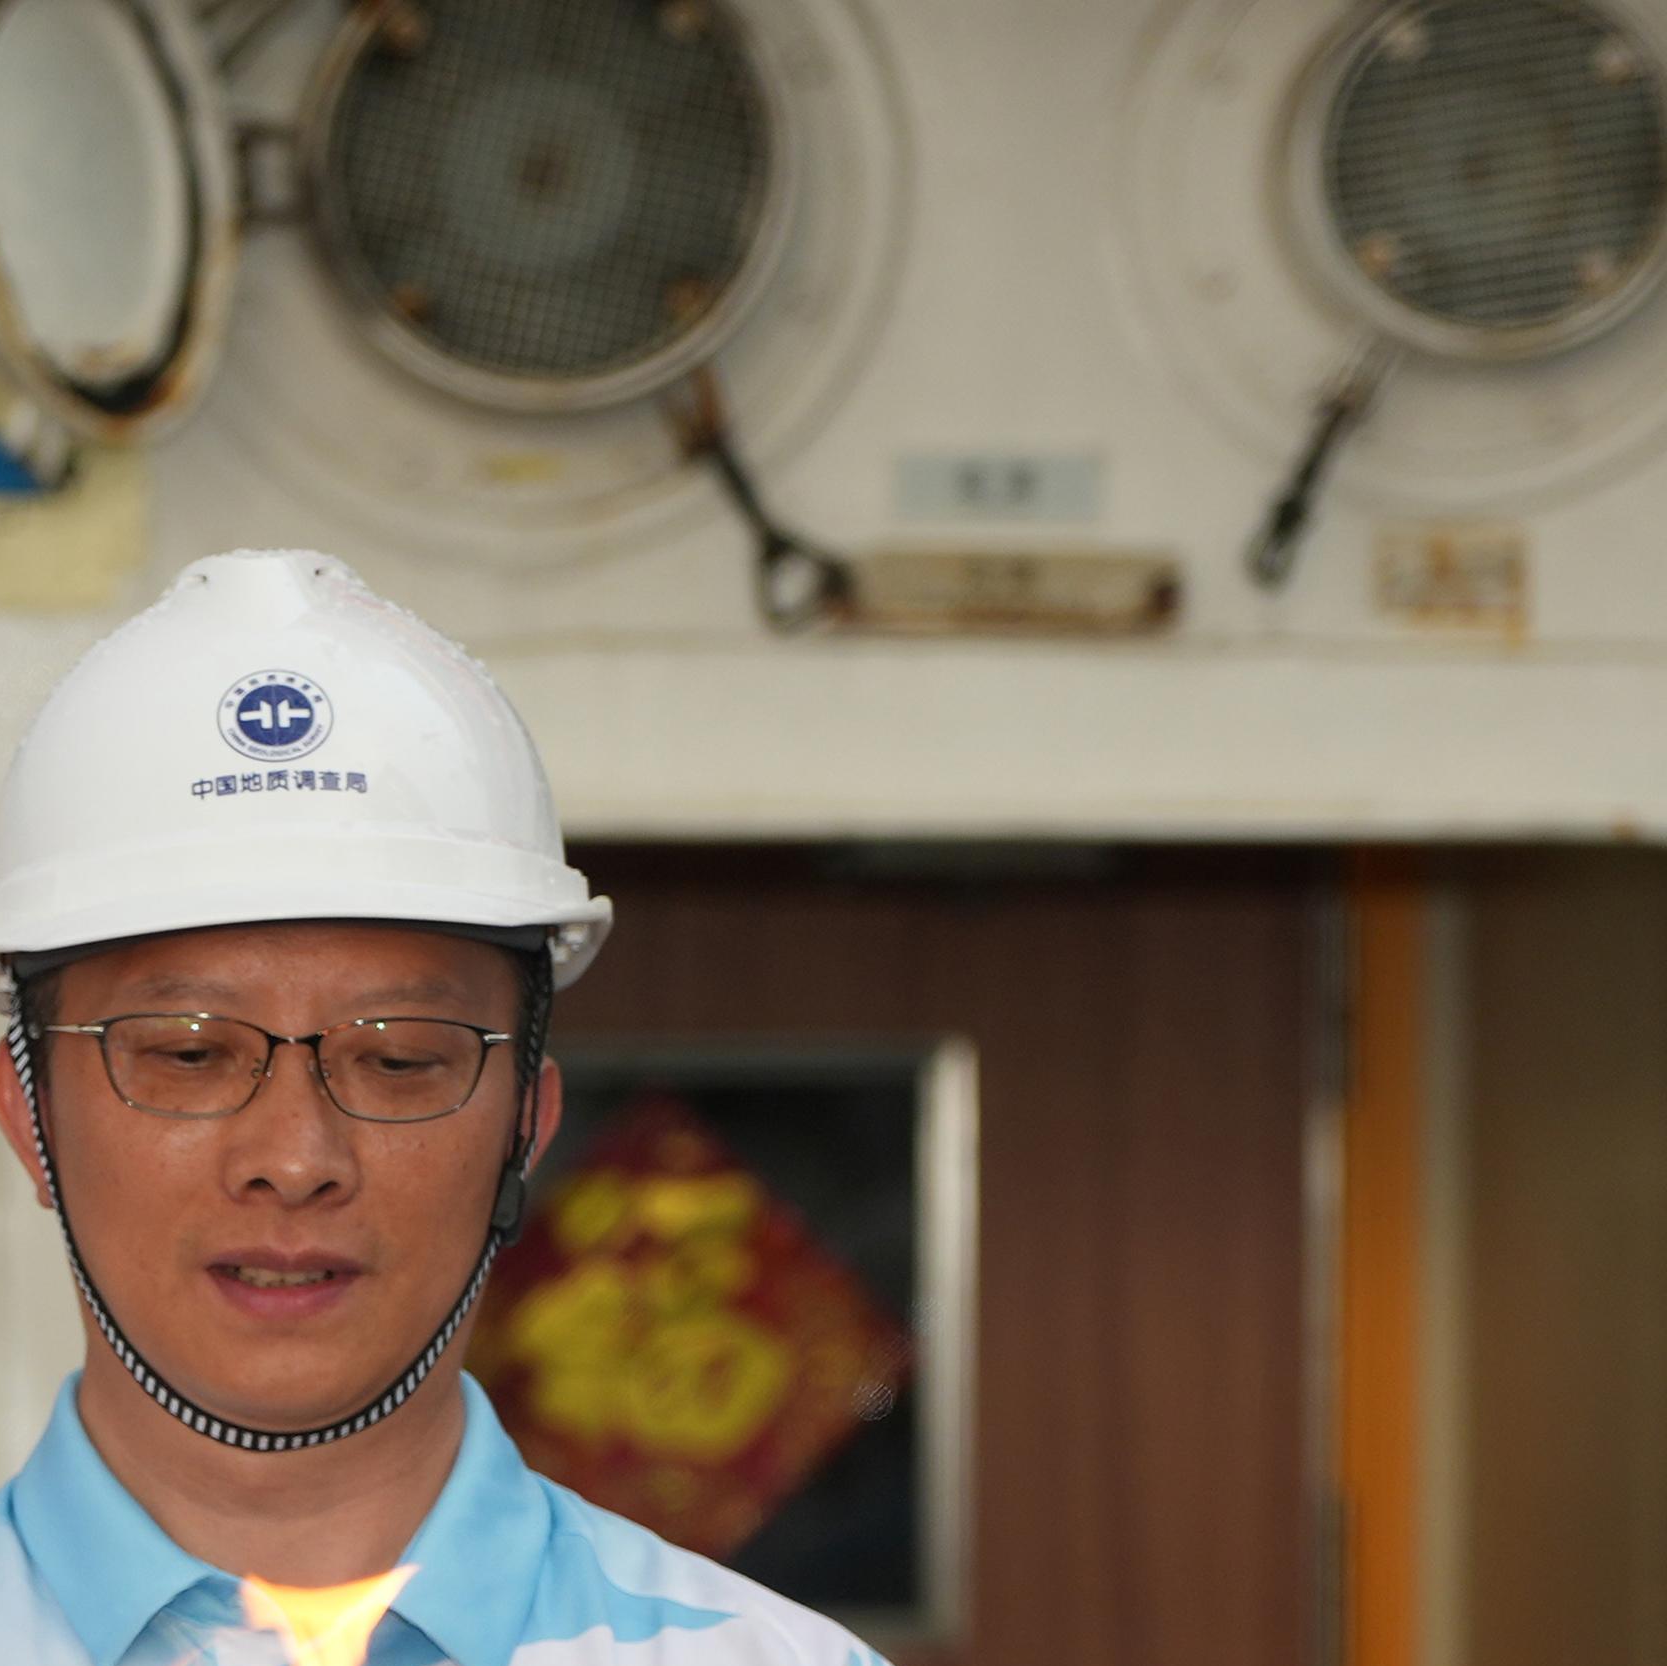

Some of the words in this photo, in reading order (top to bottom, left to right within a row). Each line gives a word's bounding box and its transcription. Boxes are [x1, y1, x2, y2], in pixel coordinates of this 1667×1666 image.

[191, 769, 368, 800] 中国地质调查局
